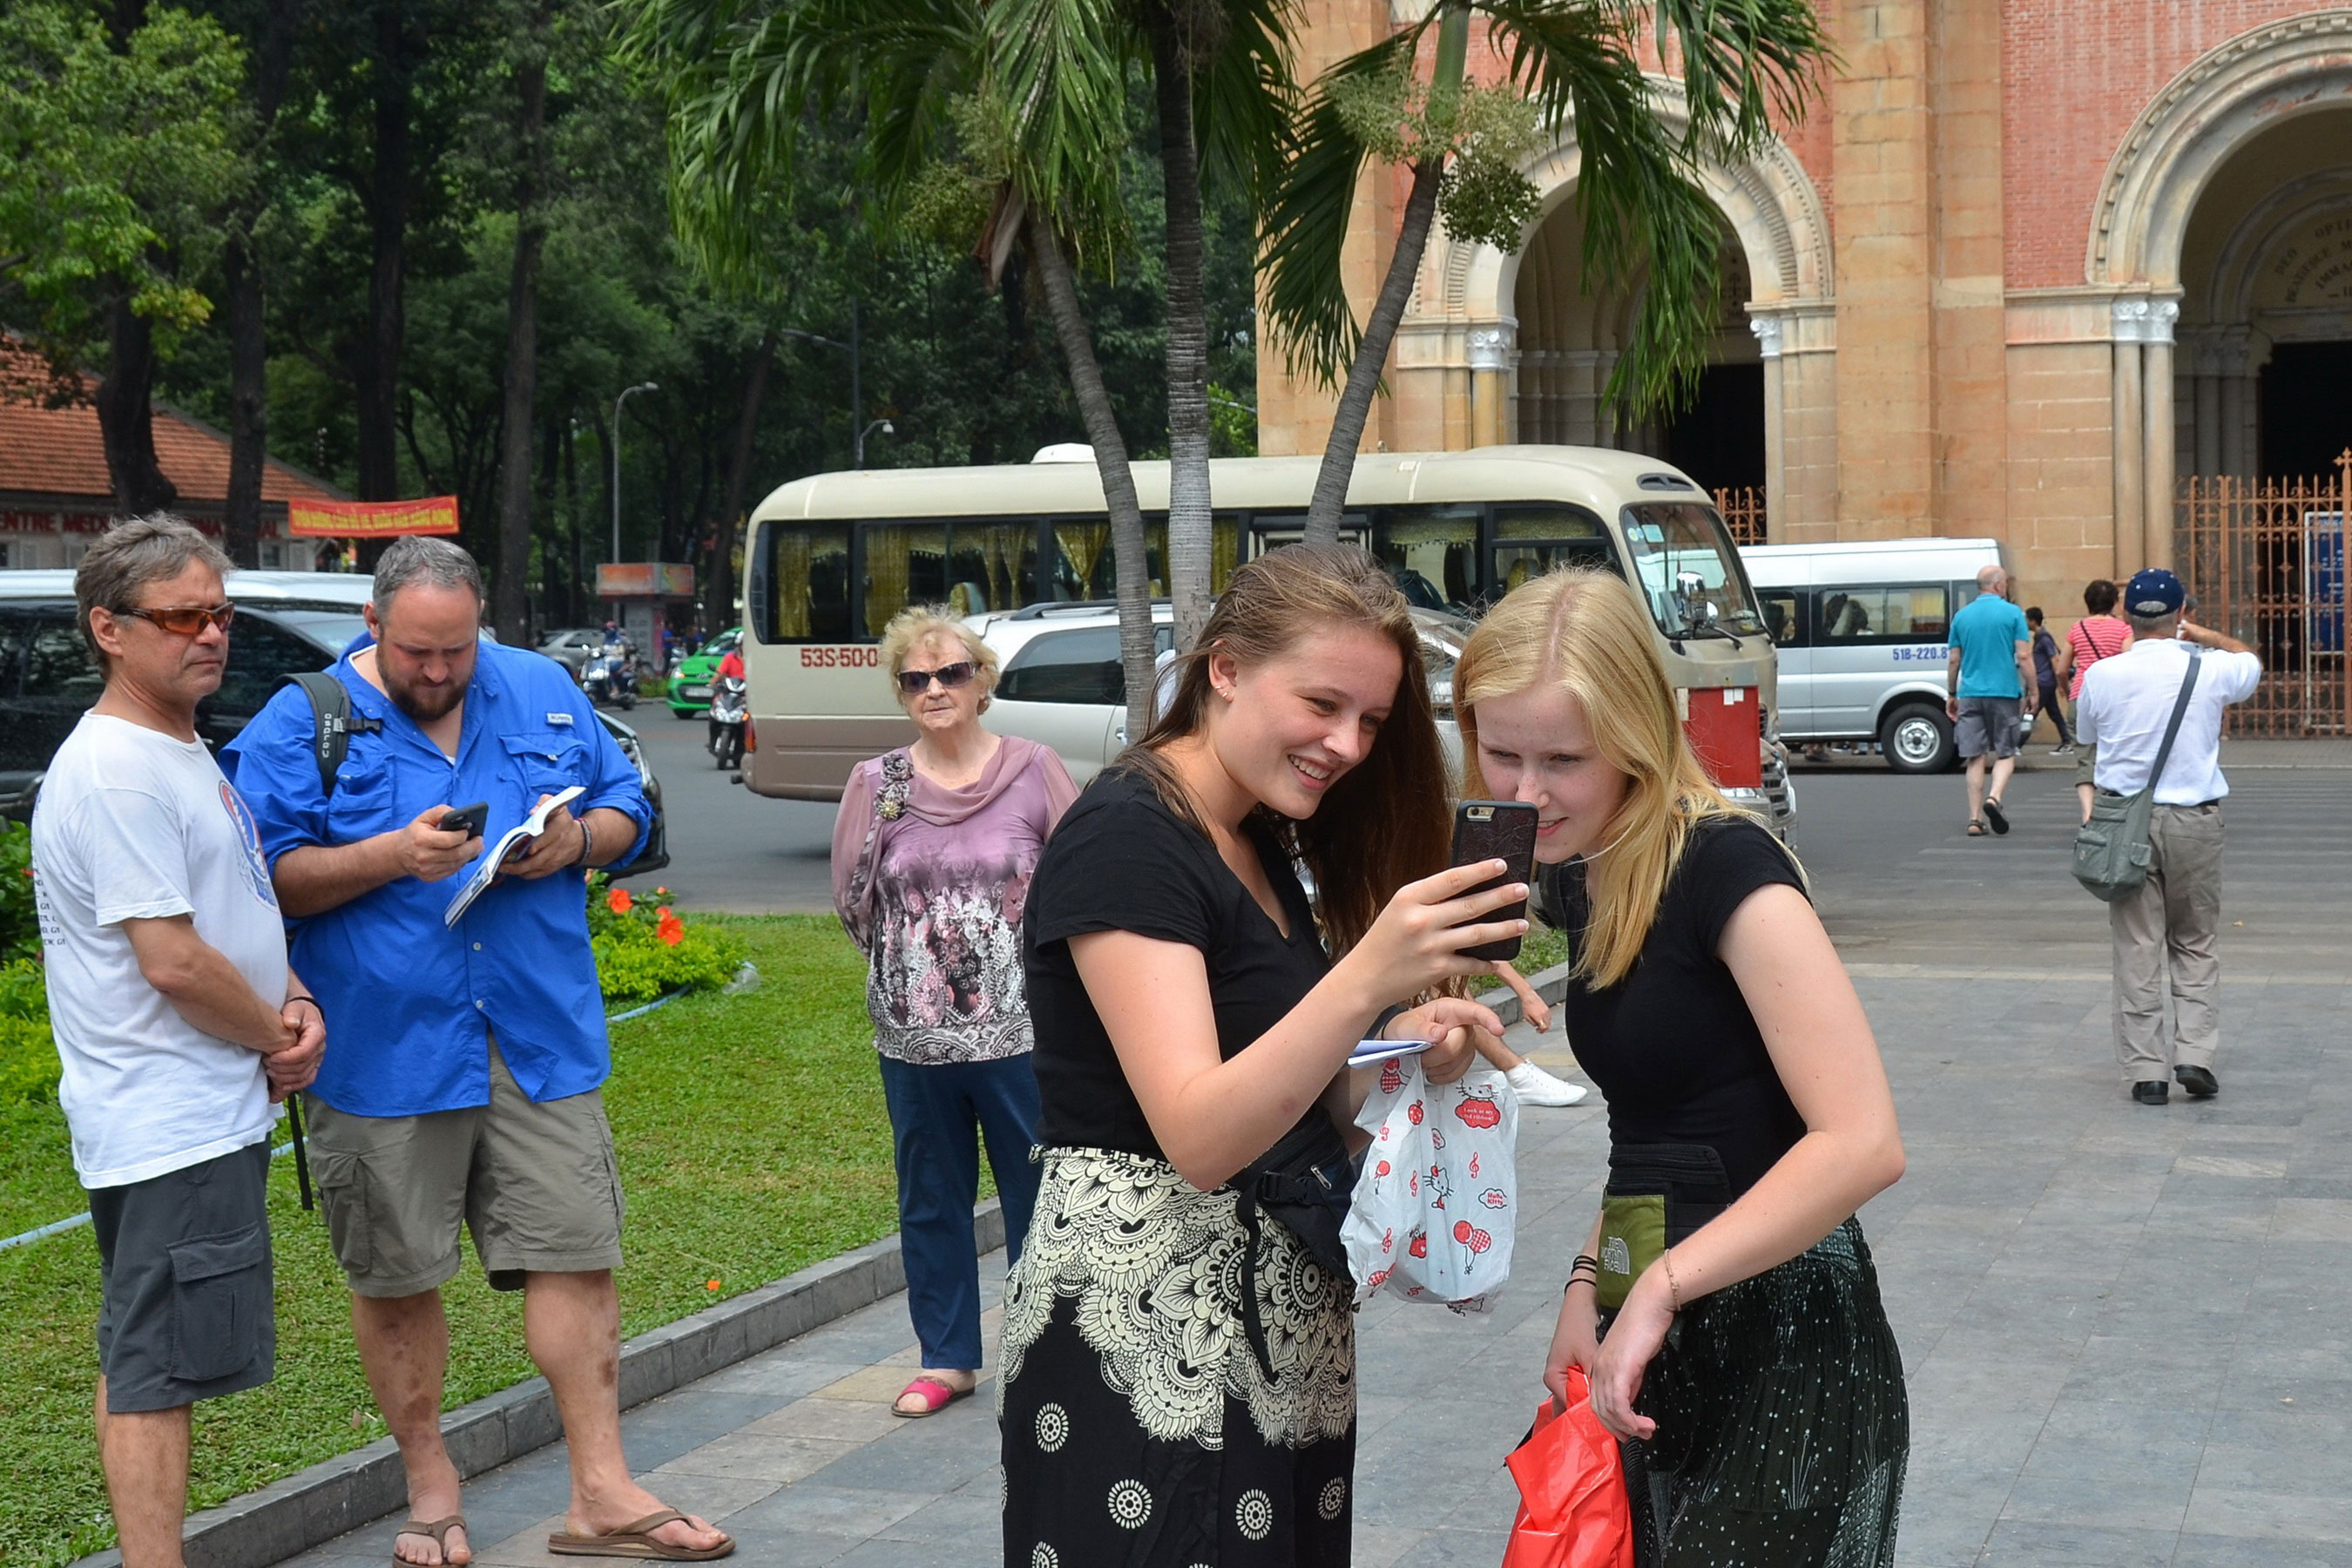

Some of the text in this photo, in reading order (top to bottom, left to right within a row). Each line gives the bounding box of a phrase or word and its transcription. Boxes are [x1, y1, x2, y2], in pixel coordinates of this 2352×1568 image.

[0, 511, 56, 532] ENTRE
[801, 647, 881, 667] 53S-50-0
[1893, 646, 1948, 660] 51B-220.8
[321, 713, 332, 759] osprey
